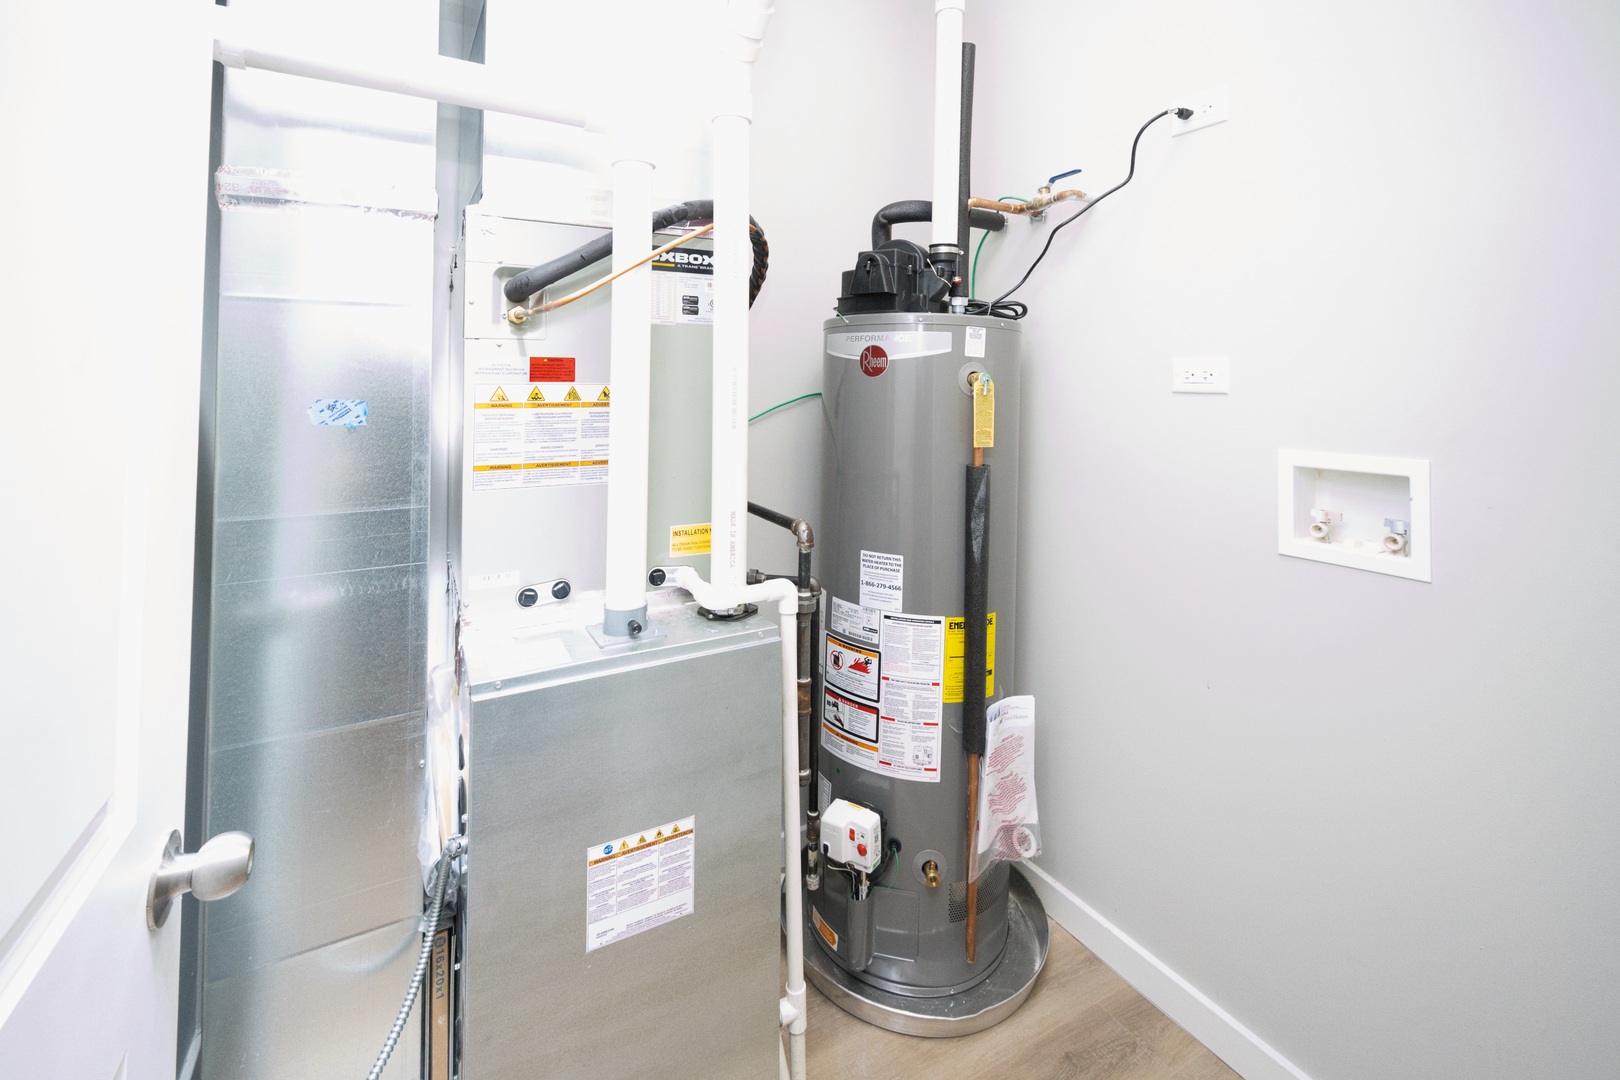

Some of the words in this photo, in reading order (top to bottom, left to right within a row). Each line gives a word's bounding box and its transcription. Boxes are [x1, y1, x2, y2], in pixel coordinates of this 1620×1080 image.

[846, 334, 911, 343] PERFORMACE
[862, 345, 887, 372] Rheem
[673, 528, 708, 537] INSTALLATION
[861, 580, 902, 592] 1-866-279-4566
[842, 644, 862, 654] WARNING
[842, 700, 859, 709] DANGER
[593, 853, 616, 865] WARNING
[621, 841, 658, 856] AVERTISSEMENT
[663, 829, 694, 842] ADVERTENCIA
[435, 948, 446, 1000] 16x20x1
